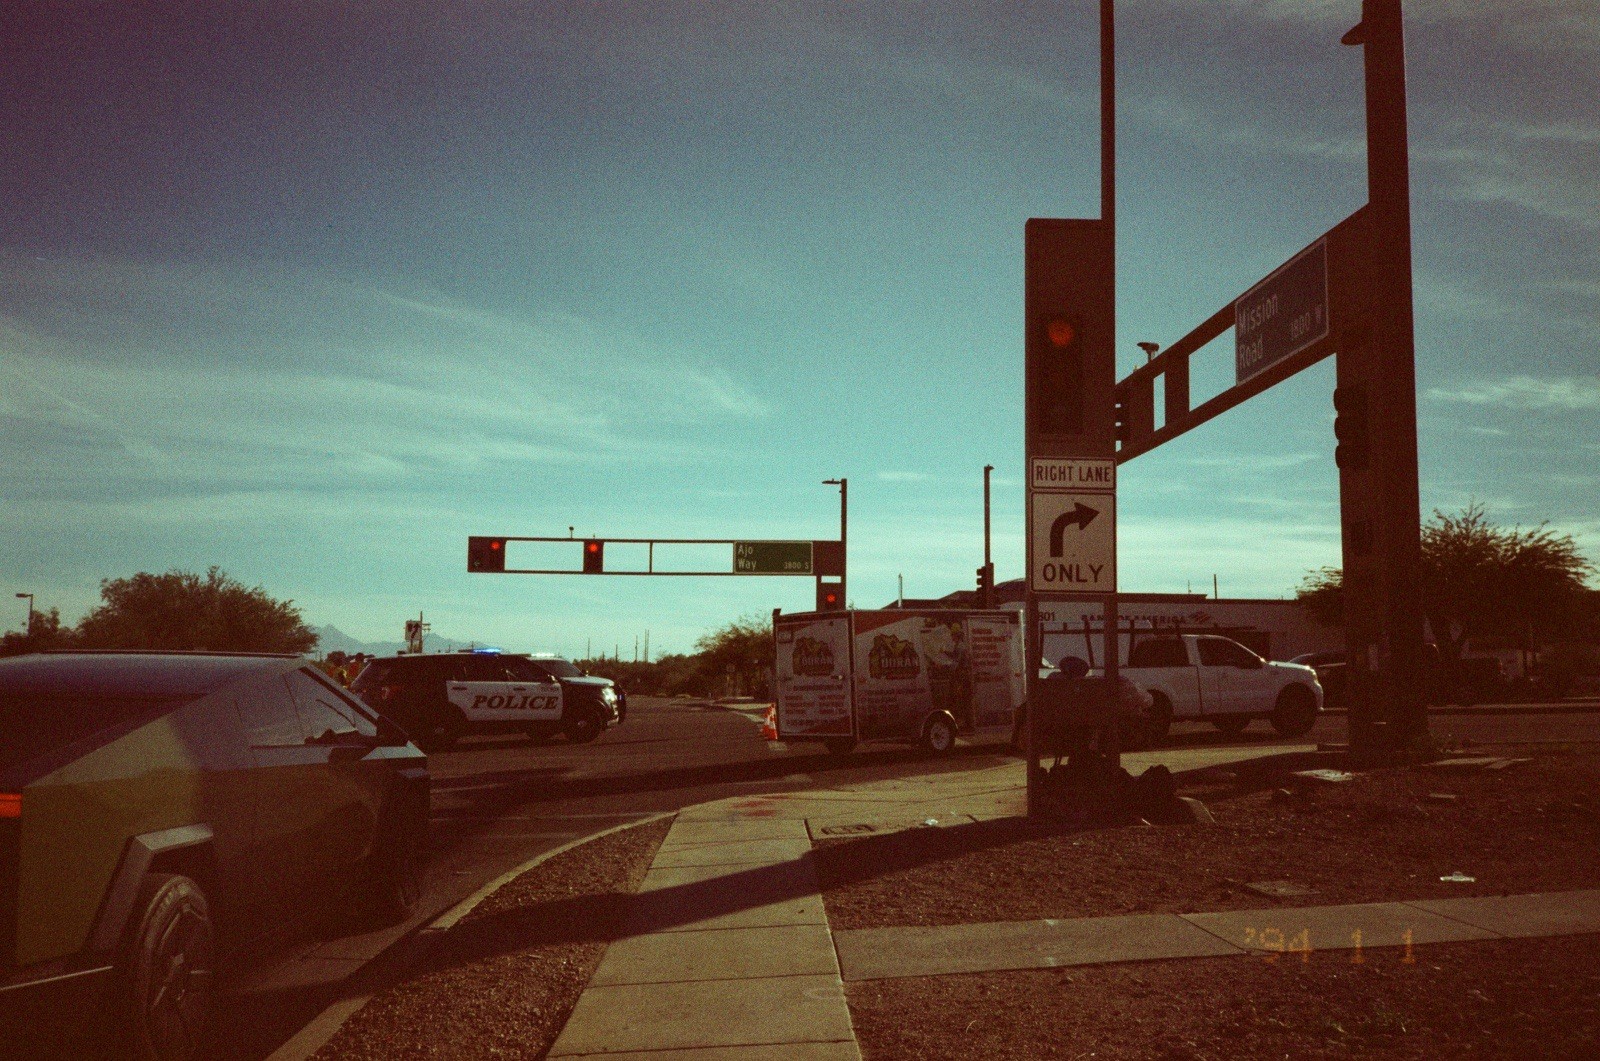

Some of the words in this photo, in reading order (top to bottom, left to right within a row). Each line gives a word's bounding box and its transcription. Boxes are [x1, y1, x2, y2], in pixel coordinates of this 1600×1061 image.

[1238, 293, 1278, 334] Mission
[1239, 335, 1262, 369] Road
[1036, 465, 1072, 481] RIGHT
[1079, 466, 1111, 482] LANE
[738, 544, 753, 558] Ajo
[738, 559, 757, 572] Way
[804, 561, 809, 570] S
[1042, 563, 1104, 583] ONLY
[470, 695, 559, 710] POLICE
